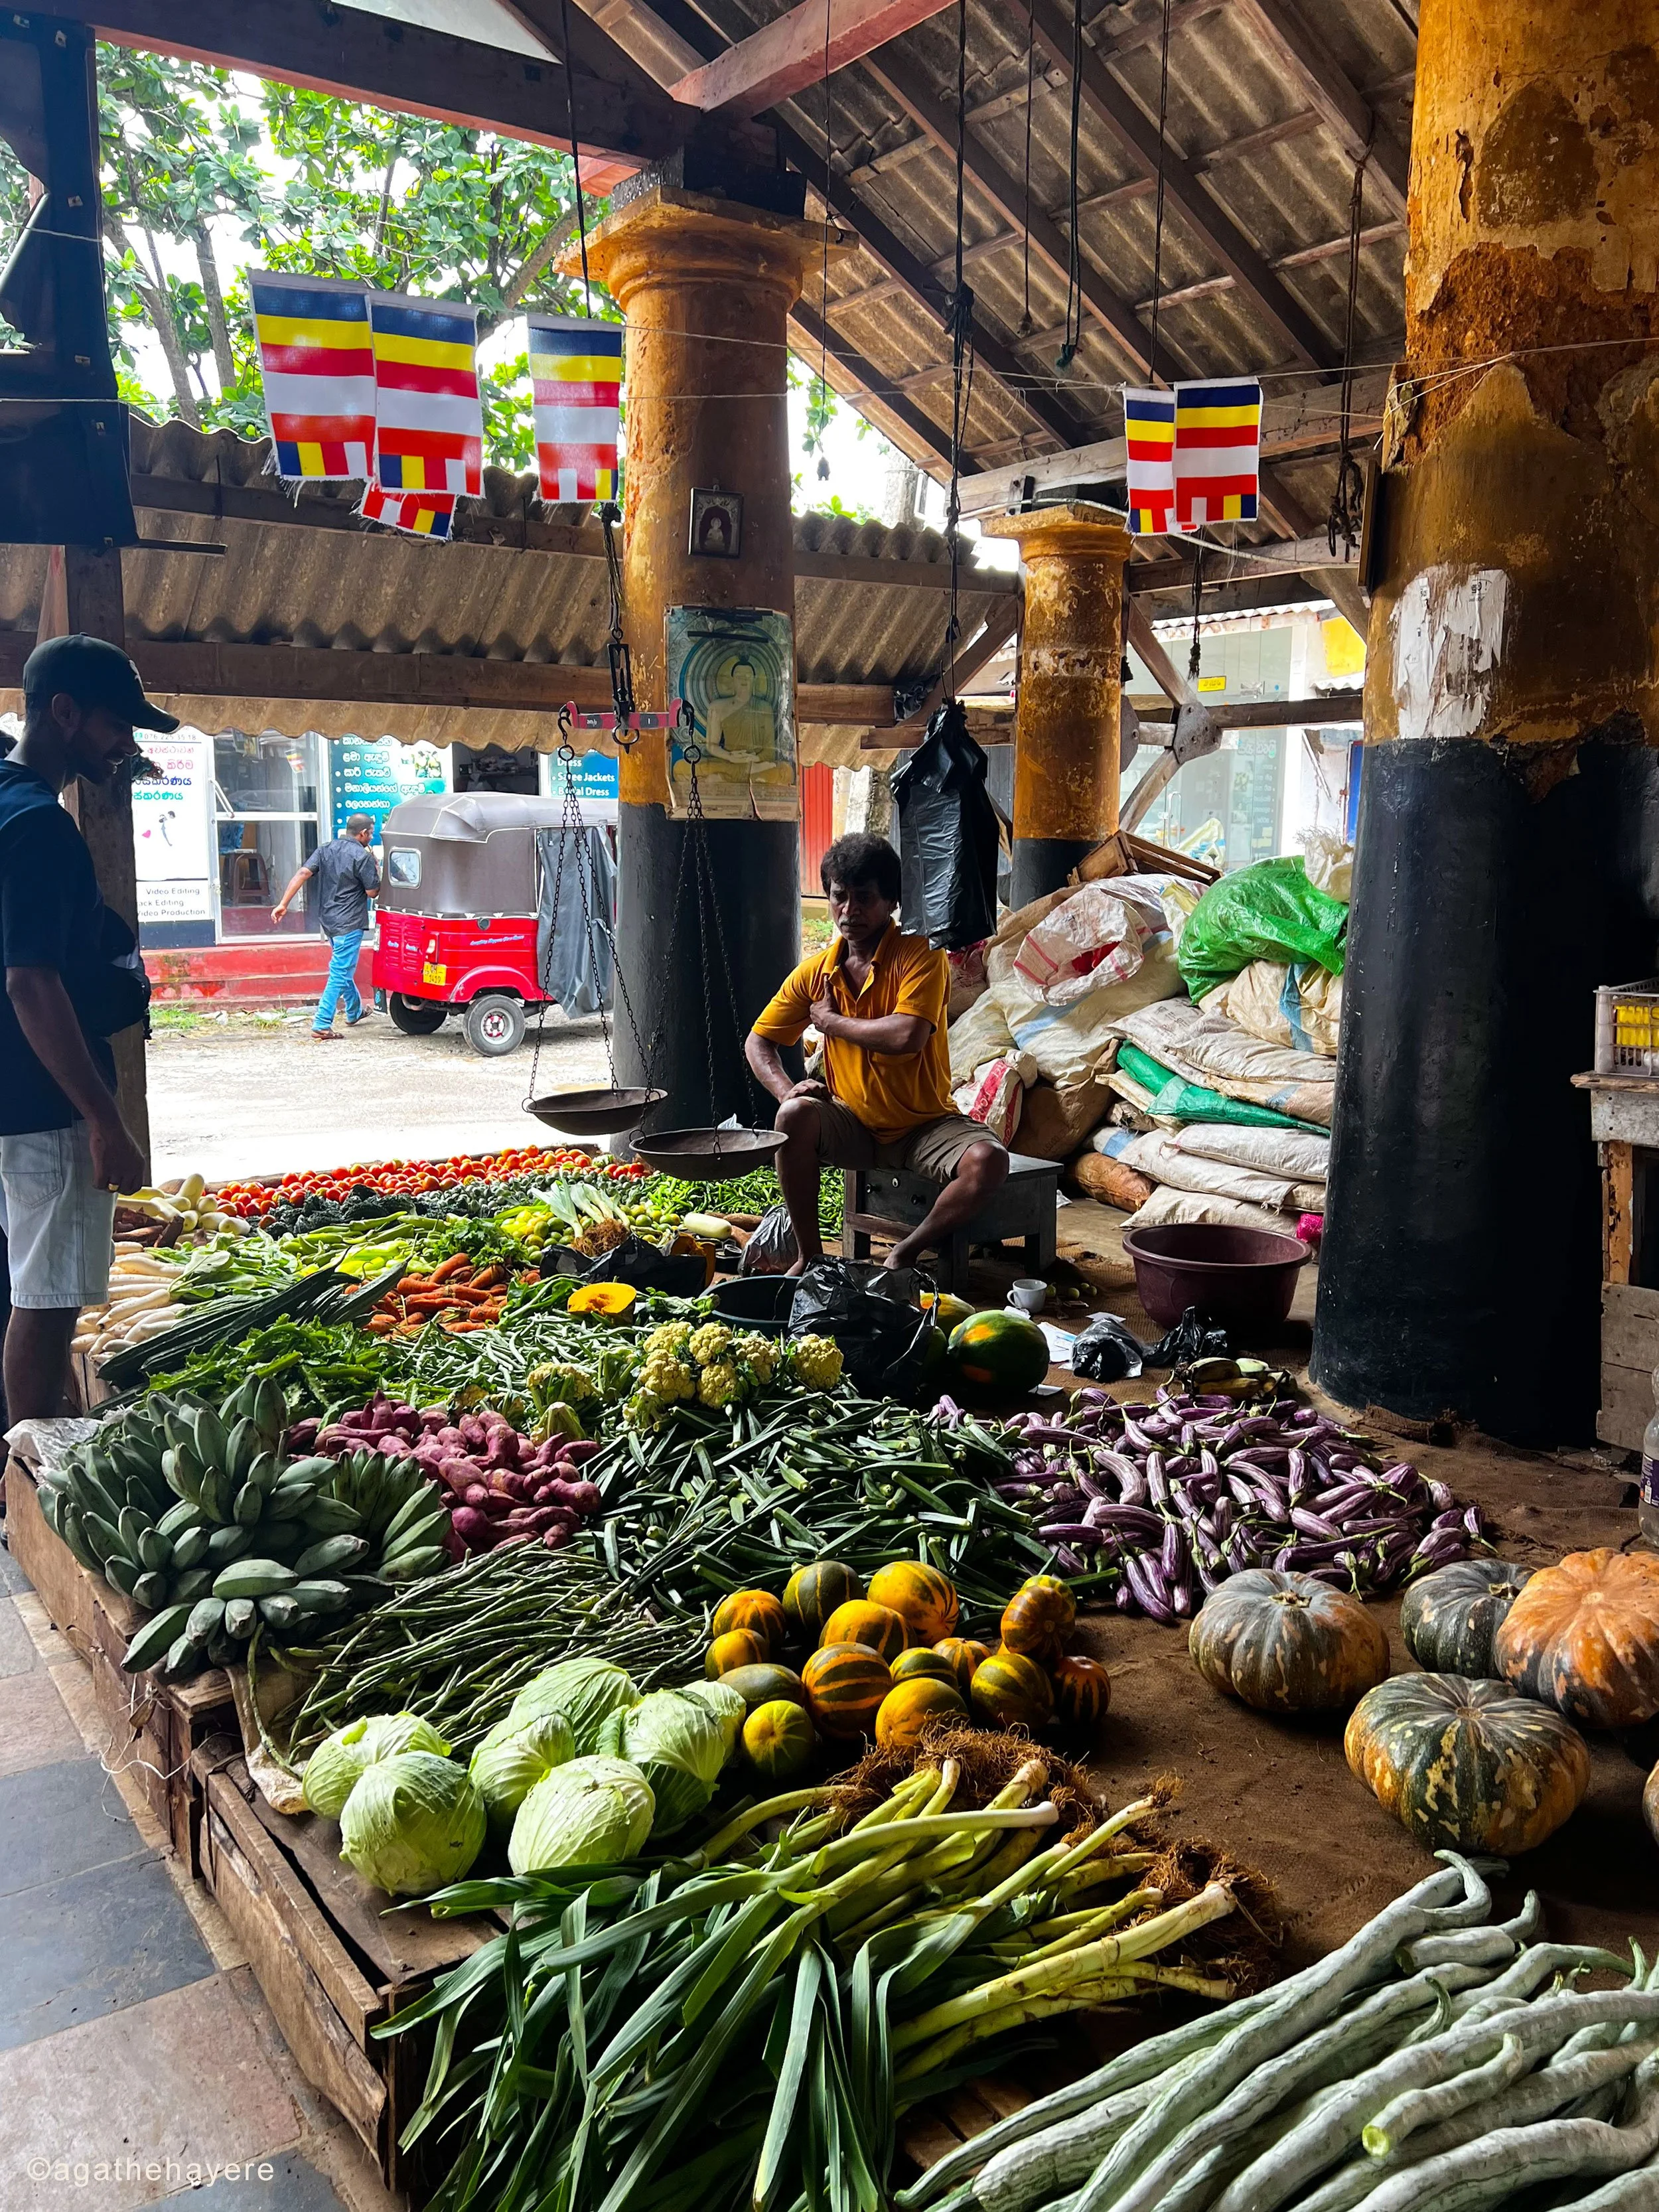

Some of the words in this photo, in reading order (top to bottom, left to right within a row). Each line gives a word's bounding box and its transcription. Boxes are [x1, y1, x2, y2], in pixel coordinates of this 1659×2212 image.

[583, 773, 615, 782] Jackets
[585, 787, 610, 796] Dress
[171, 887, 200, 896] Editing
